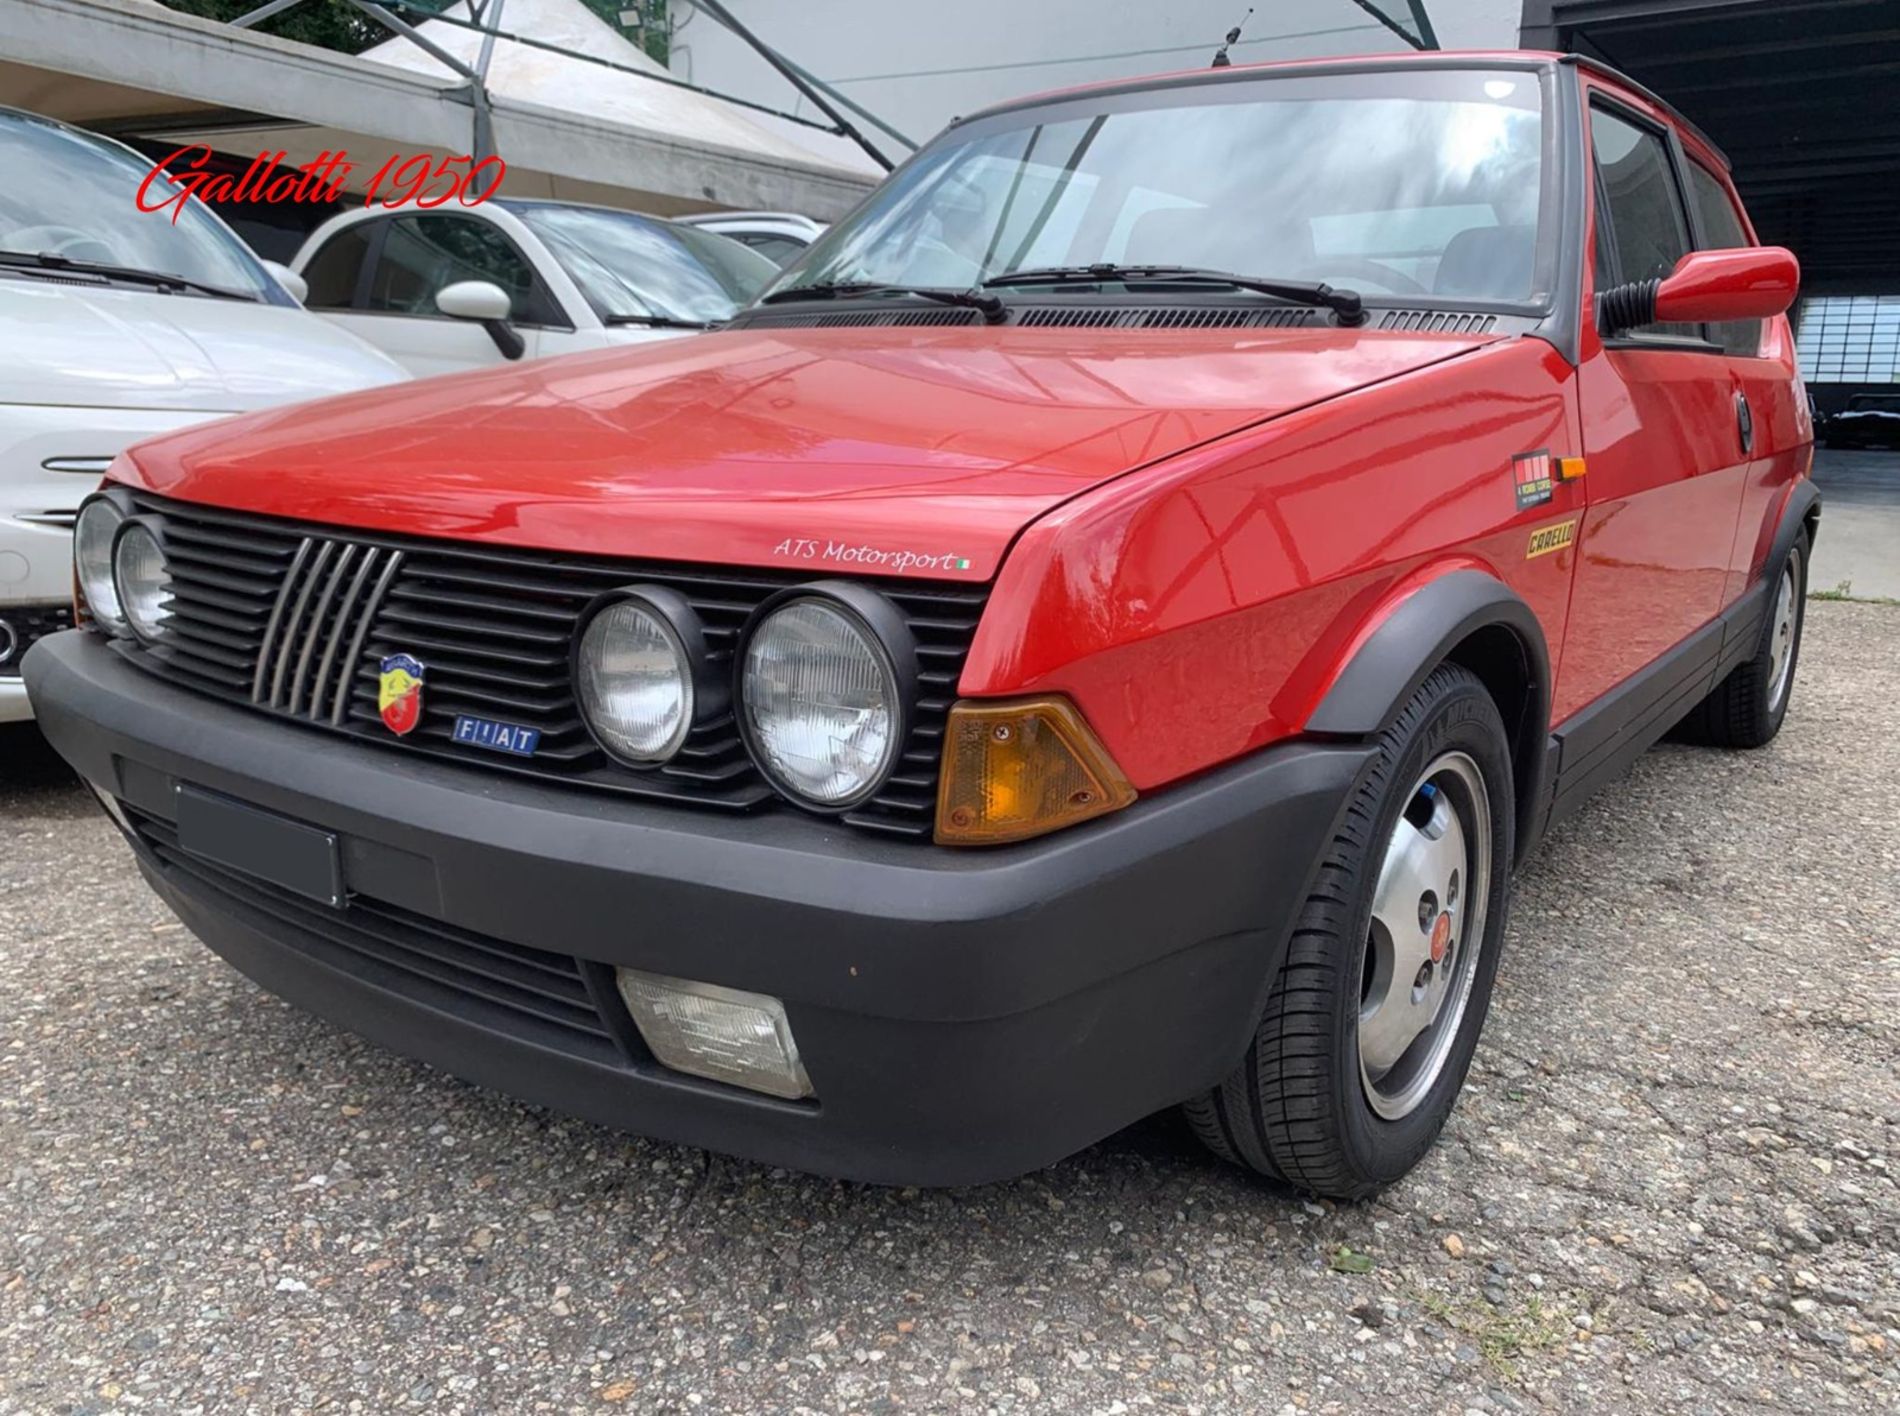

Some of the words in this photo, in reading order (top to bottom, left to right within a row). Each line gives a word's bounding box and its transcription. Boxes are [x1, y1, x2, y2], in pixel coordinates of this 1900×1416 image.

[1528, 523, 1575, 554] CARELLO
[774, 538, 819, 558] ATS
[822, 540, 958, 572] Motorsport
[459, 719, 532, 750] FIAT
